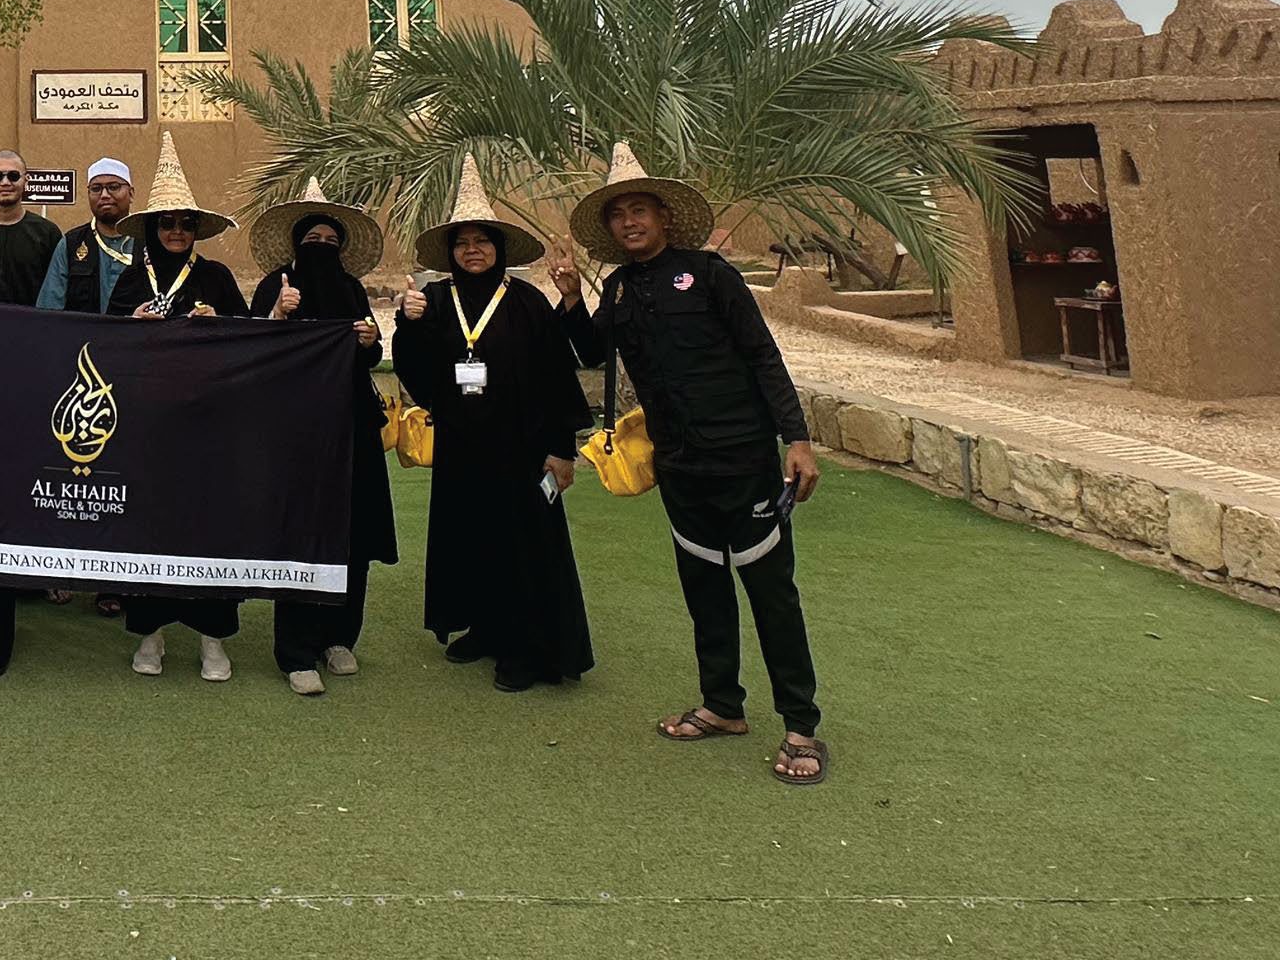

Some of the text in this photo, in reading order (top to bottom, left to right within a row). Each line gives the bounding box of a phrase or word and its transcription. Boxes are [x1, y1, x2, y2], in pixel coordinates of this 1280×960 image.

[39, 82, 139, 104] متحف العمودي
[98, 101, 119, 110] مكة
[52, 185, 70, 193] HALL
[31, 479, 127, 502] AL KHAIRI
[33, 497, 124, 515] TRAVEL & TOURS
[57, 510, 99, 522] SDN BHD
[80, 558, 161, 577] TERINDAH
[166, 564, 238, 580] BERSAMA
[241, 568, 316, 583] ALKHAIRI
